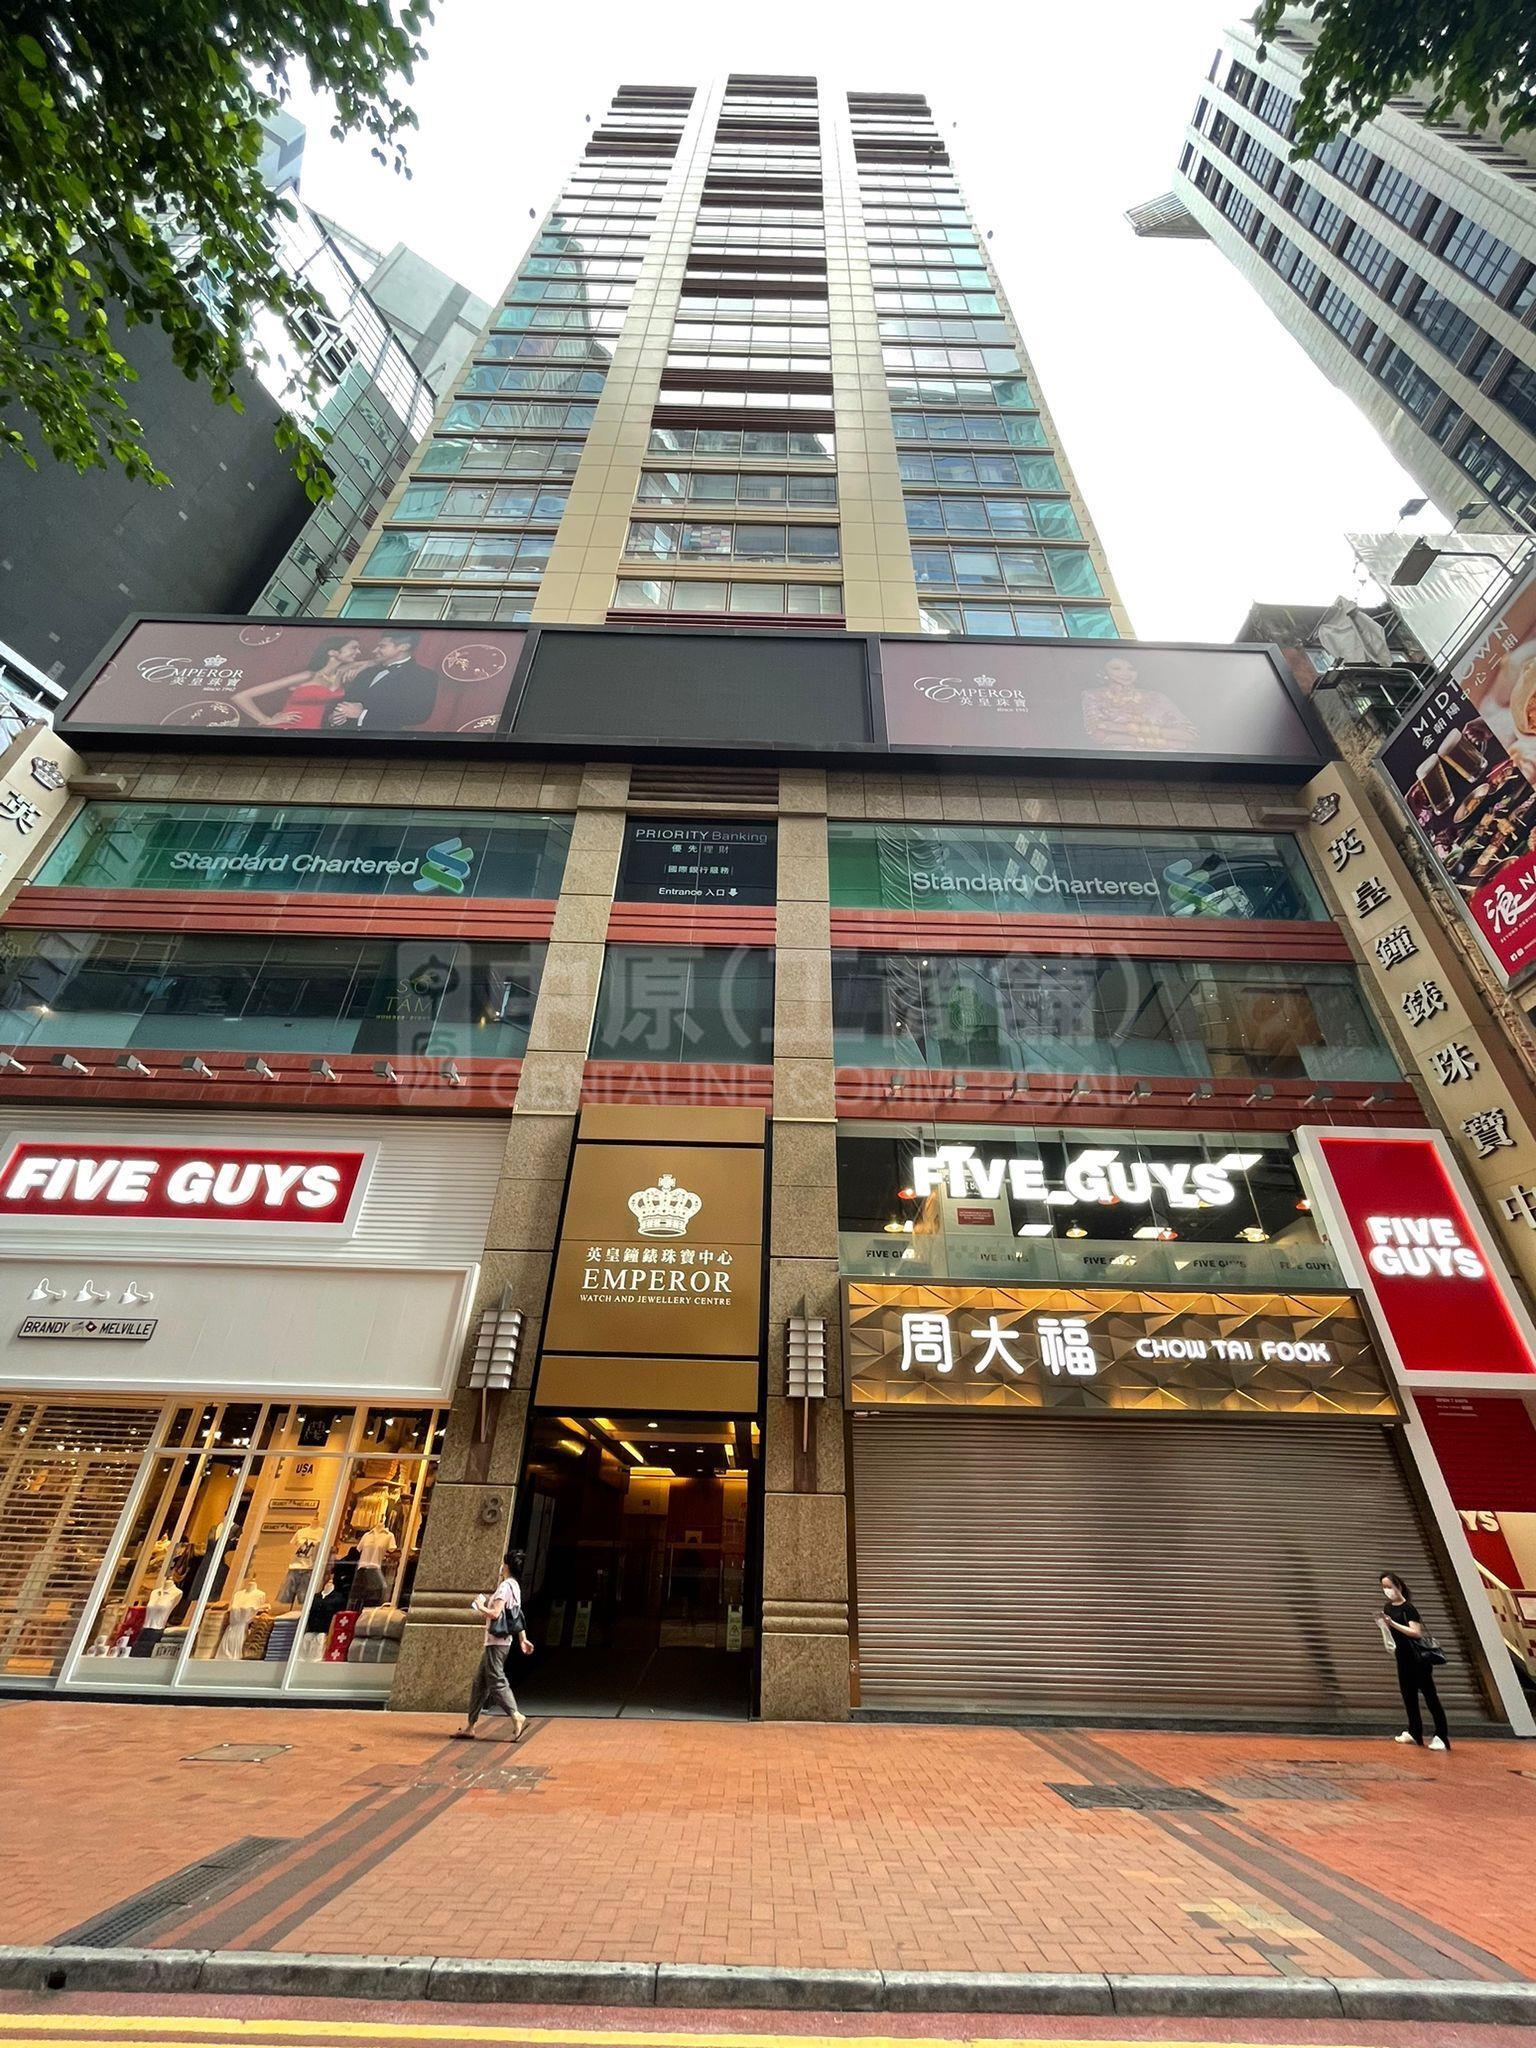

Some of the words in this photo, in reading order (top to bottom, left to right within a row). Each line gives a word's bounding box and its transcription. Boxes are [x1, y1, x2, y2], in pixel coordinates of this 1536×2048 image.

[137, 656, 244, 683] EMPEROR
[1411, 620, 1510, 739] MIDTOWN
[913, 676, 1025, 703] EMPEROR
[635, 829, 709, 841] PRIORITY
[711, 831, 768, 843] Banking
[671, 844, 730, 854] 優先理財
[169, 851, 289, 872] Standard
[291, 854, 419, 875] Chartered
[658, 888, 703, 897] Entrance
[705, 888, 725, 897] 入口
[912, 872, 1027, 892] Standard
[1033, 874, 1159, 896] Chartered
[5, 1157, 159, 1202] FIVE
[165, 1161, 341, 1208] GUYS
[912, 1156, 1049, 1200] FIVE
[1065, 1159, 1236, 1206] GUYS
[1365, 1216, 1462, 1246] FIVE
[586, 1247, 734, 1266] 英皇鐘錶珠寶中心
[1083, 1256, 1107, 1266] FIVE
[1193, 1259, 1216, 1268] FIVE
[1369, 1245, 1485, 1279] GUYS
[581, 1268, 733, 1293] EMPEROR
[580, 1294, 612, 1303] WATCH
[613, 1295, 635, 1304] AND
[637, 1295, 692, 1305] JEWELLERY
[694, 1297, 732, 1306] CENTRE
[23, 1321, 70, 1334] BRANDY
[98, 1322, 152, 1336] MELVILLE
[900, 1313, 1098, 1377] 周大福
[1135, 1338, 1207, 1360] CHOW
[1211, 1340, 1255, 1361] TAI
[1262, 1341, 1332, 1363] FOOK
[296, 1463, 314, 1474] USA
